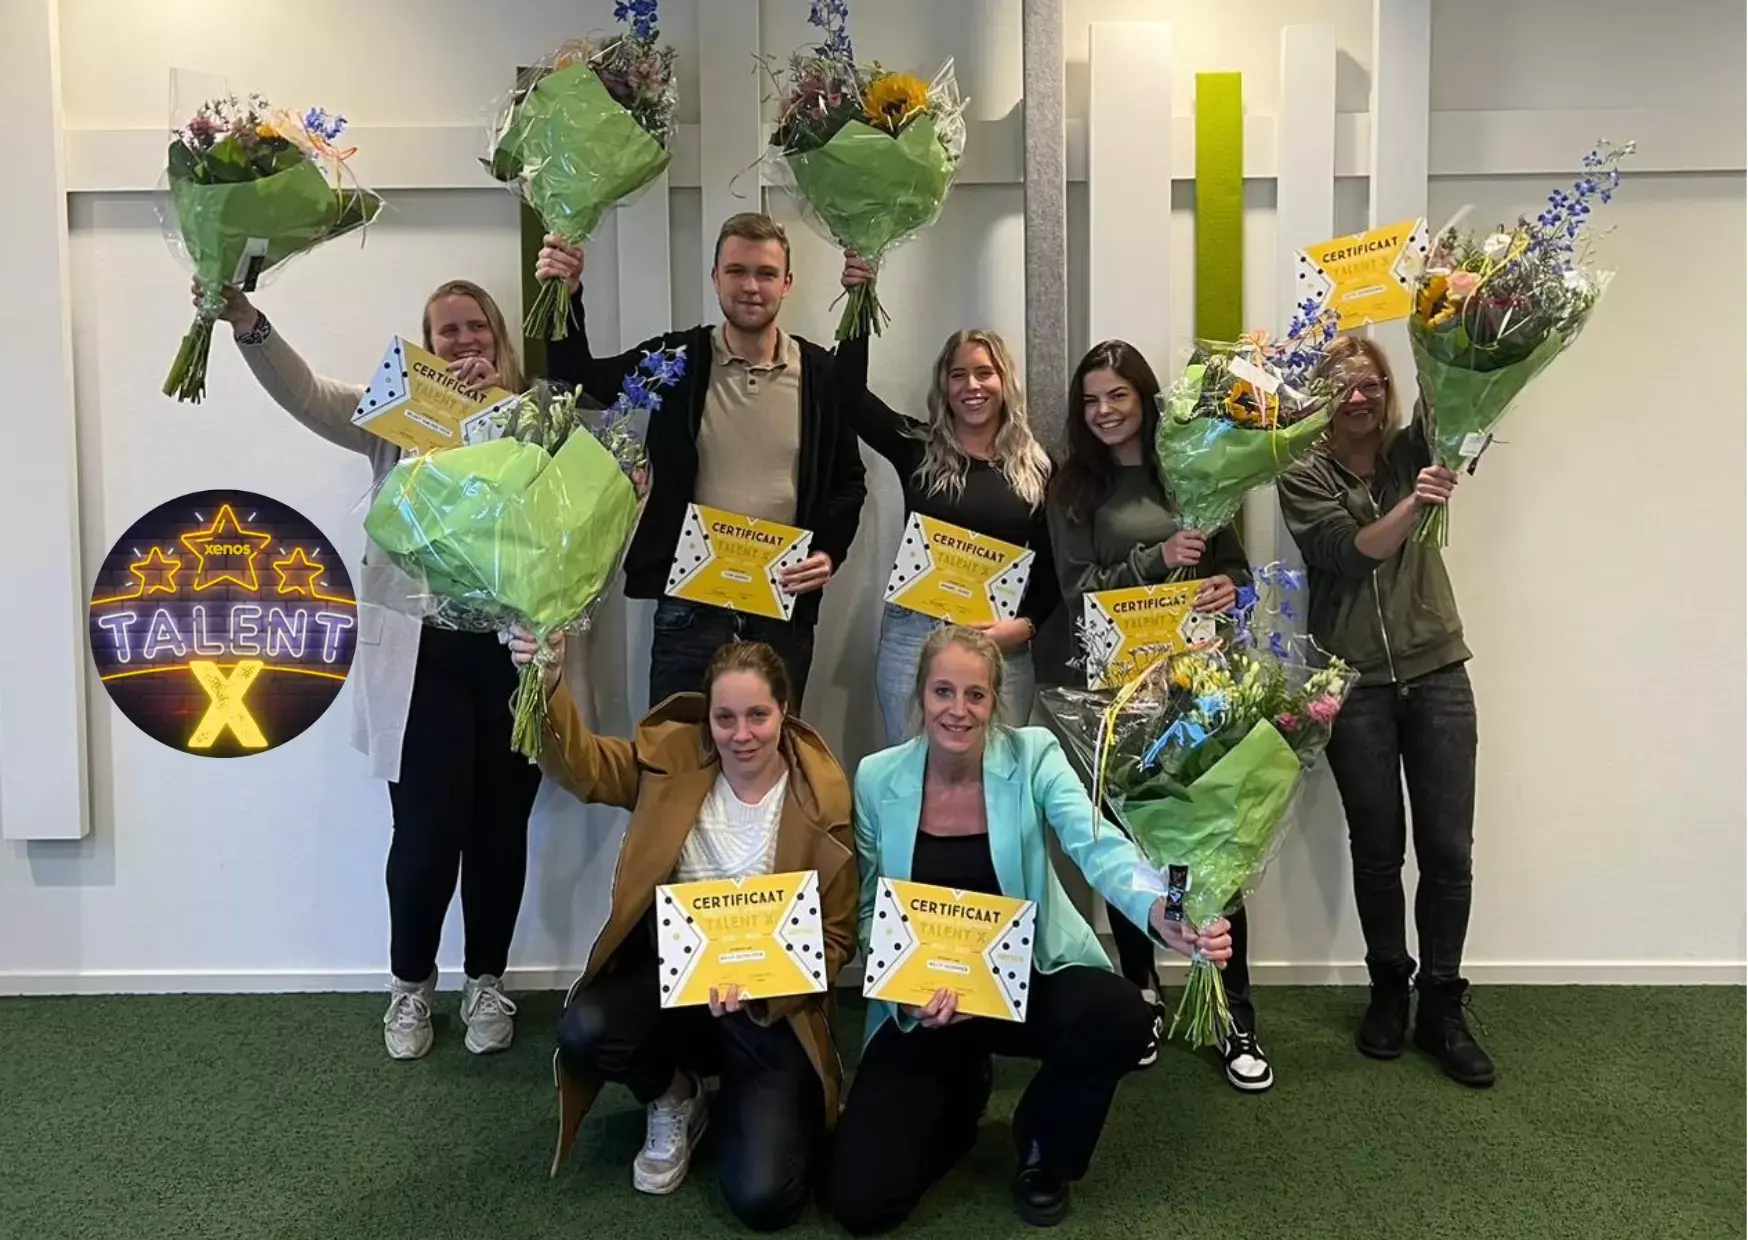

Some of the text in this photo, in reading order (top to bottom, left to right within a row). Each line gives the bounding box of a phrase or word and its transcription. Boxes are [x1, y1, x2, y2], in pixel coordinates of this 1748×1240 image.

[1322, 235, 1399, 263] CERTIFICAAT
[711, 522, 784, 546] CERTIFICAAT
[932, 532, 1006, 563] CERTIFICAAT
[1112, 593, 1187, 613] CERTIFICAAT
[692, 889, 786, 911] CERTIFICAAT
[910, 898, 1002, 925] CERTIFICAAT
[706, 917, 758, 932] TALENT
[919, 922, 974, 942] TALENT
